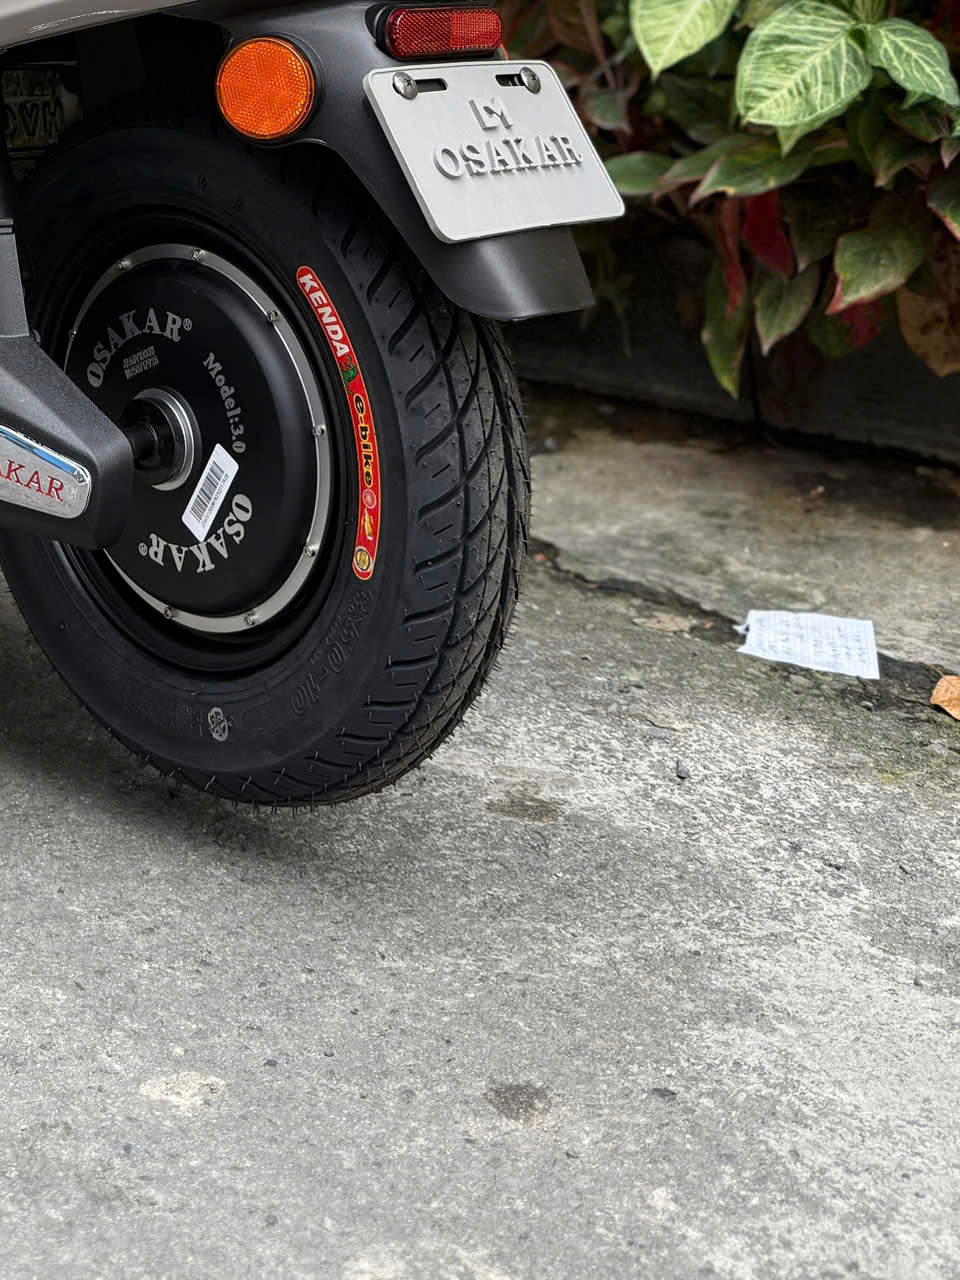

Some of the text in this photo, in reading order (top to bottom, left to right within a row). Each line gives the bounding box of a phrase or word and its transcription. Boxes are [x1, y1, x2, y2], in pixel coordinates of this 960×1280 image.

[432, 133, 584, 180] OSAKAR
[298, 273, 351, 354] KENDA
[202, 351, 246, 454] Model:3.0
[353, 393, 374, 489] e-bike
